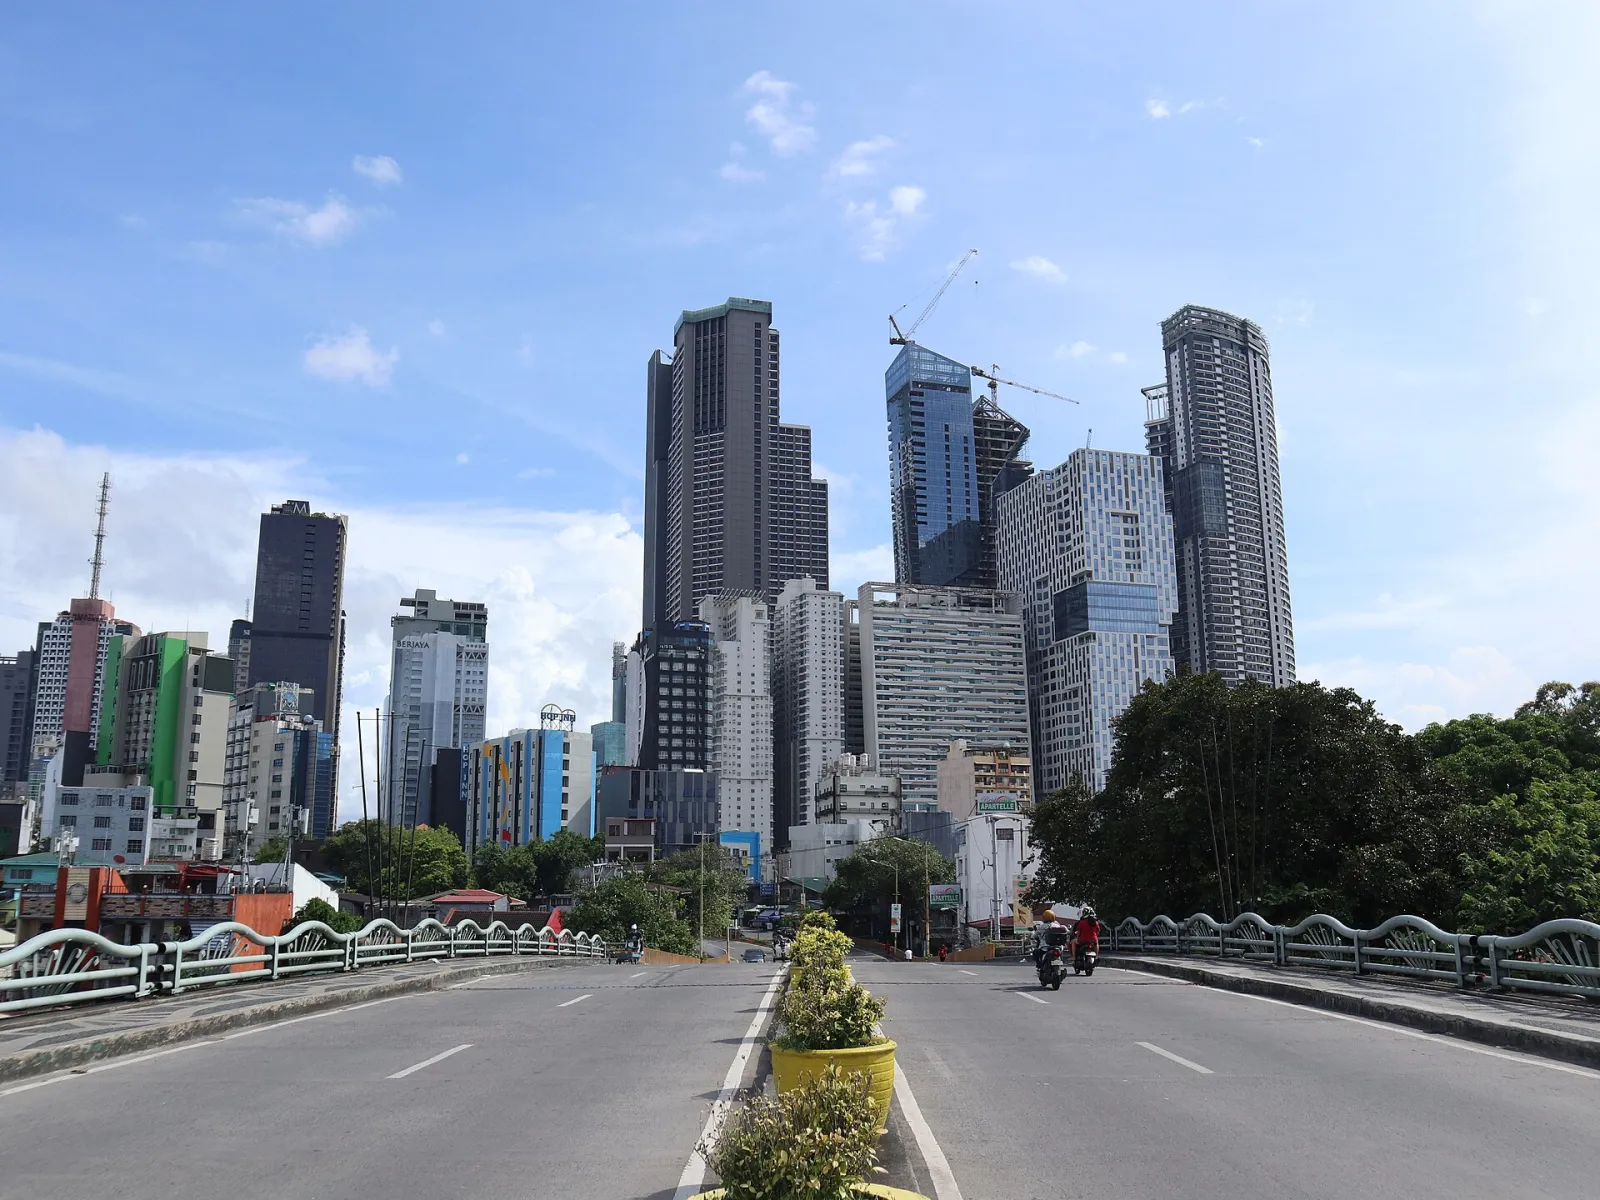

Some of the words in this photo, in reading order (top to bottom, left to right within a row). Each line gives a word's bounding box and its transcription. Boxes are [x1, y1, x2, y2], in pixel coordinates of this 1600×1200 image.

[396, 640, 430, 649] BERJAYA
[541, 711, 559, 721] HOP
[560, 713, 576, 722] INN
[461, 773, 469, 799] INN
